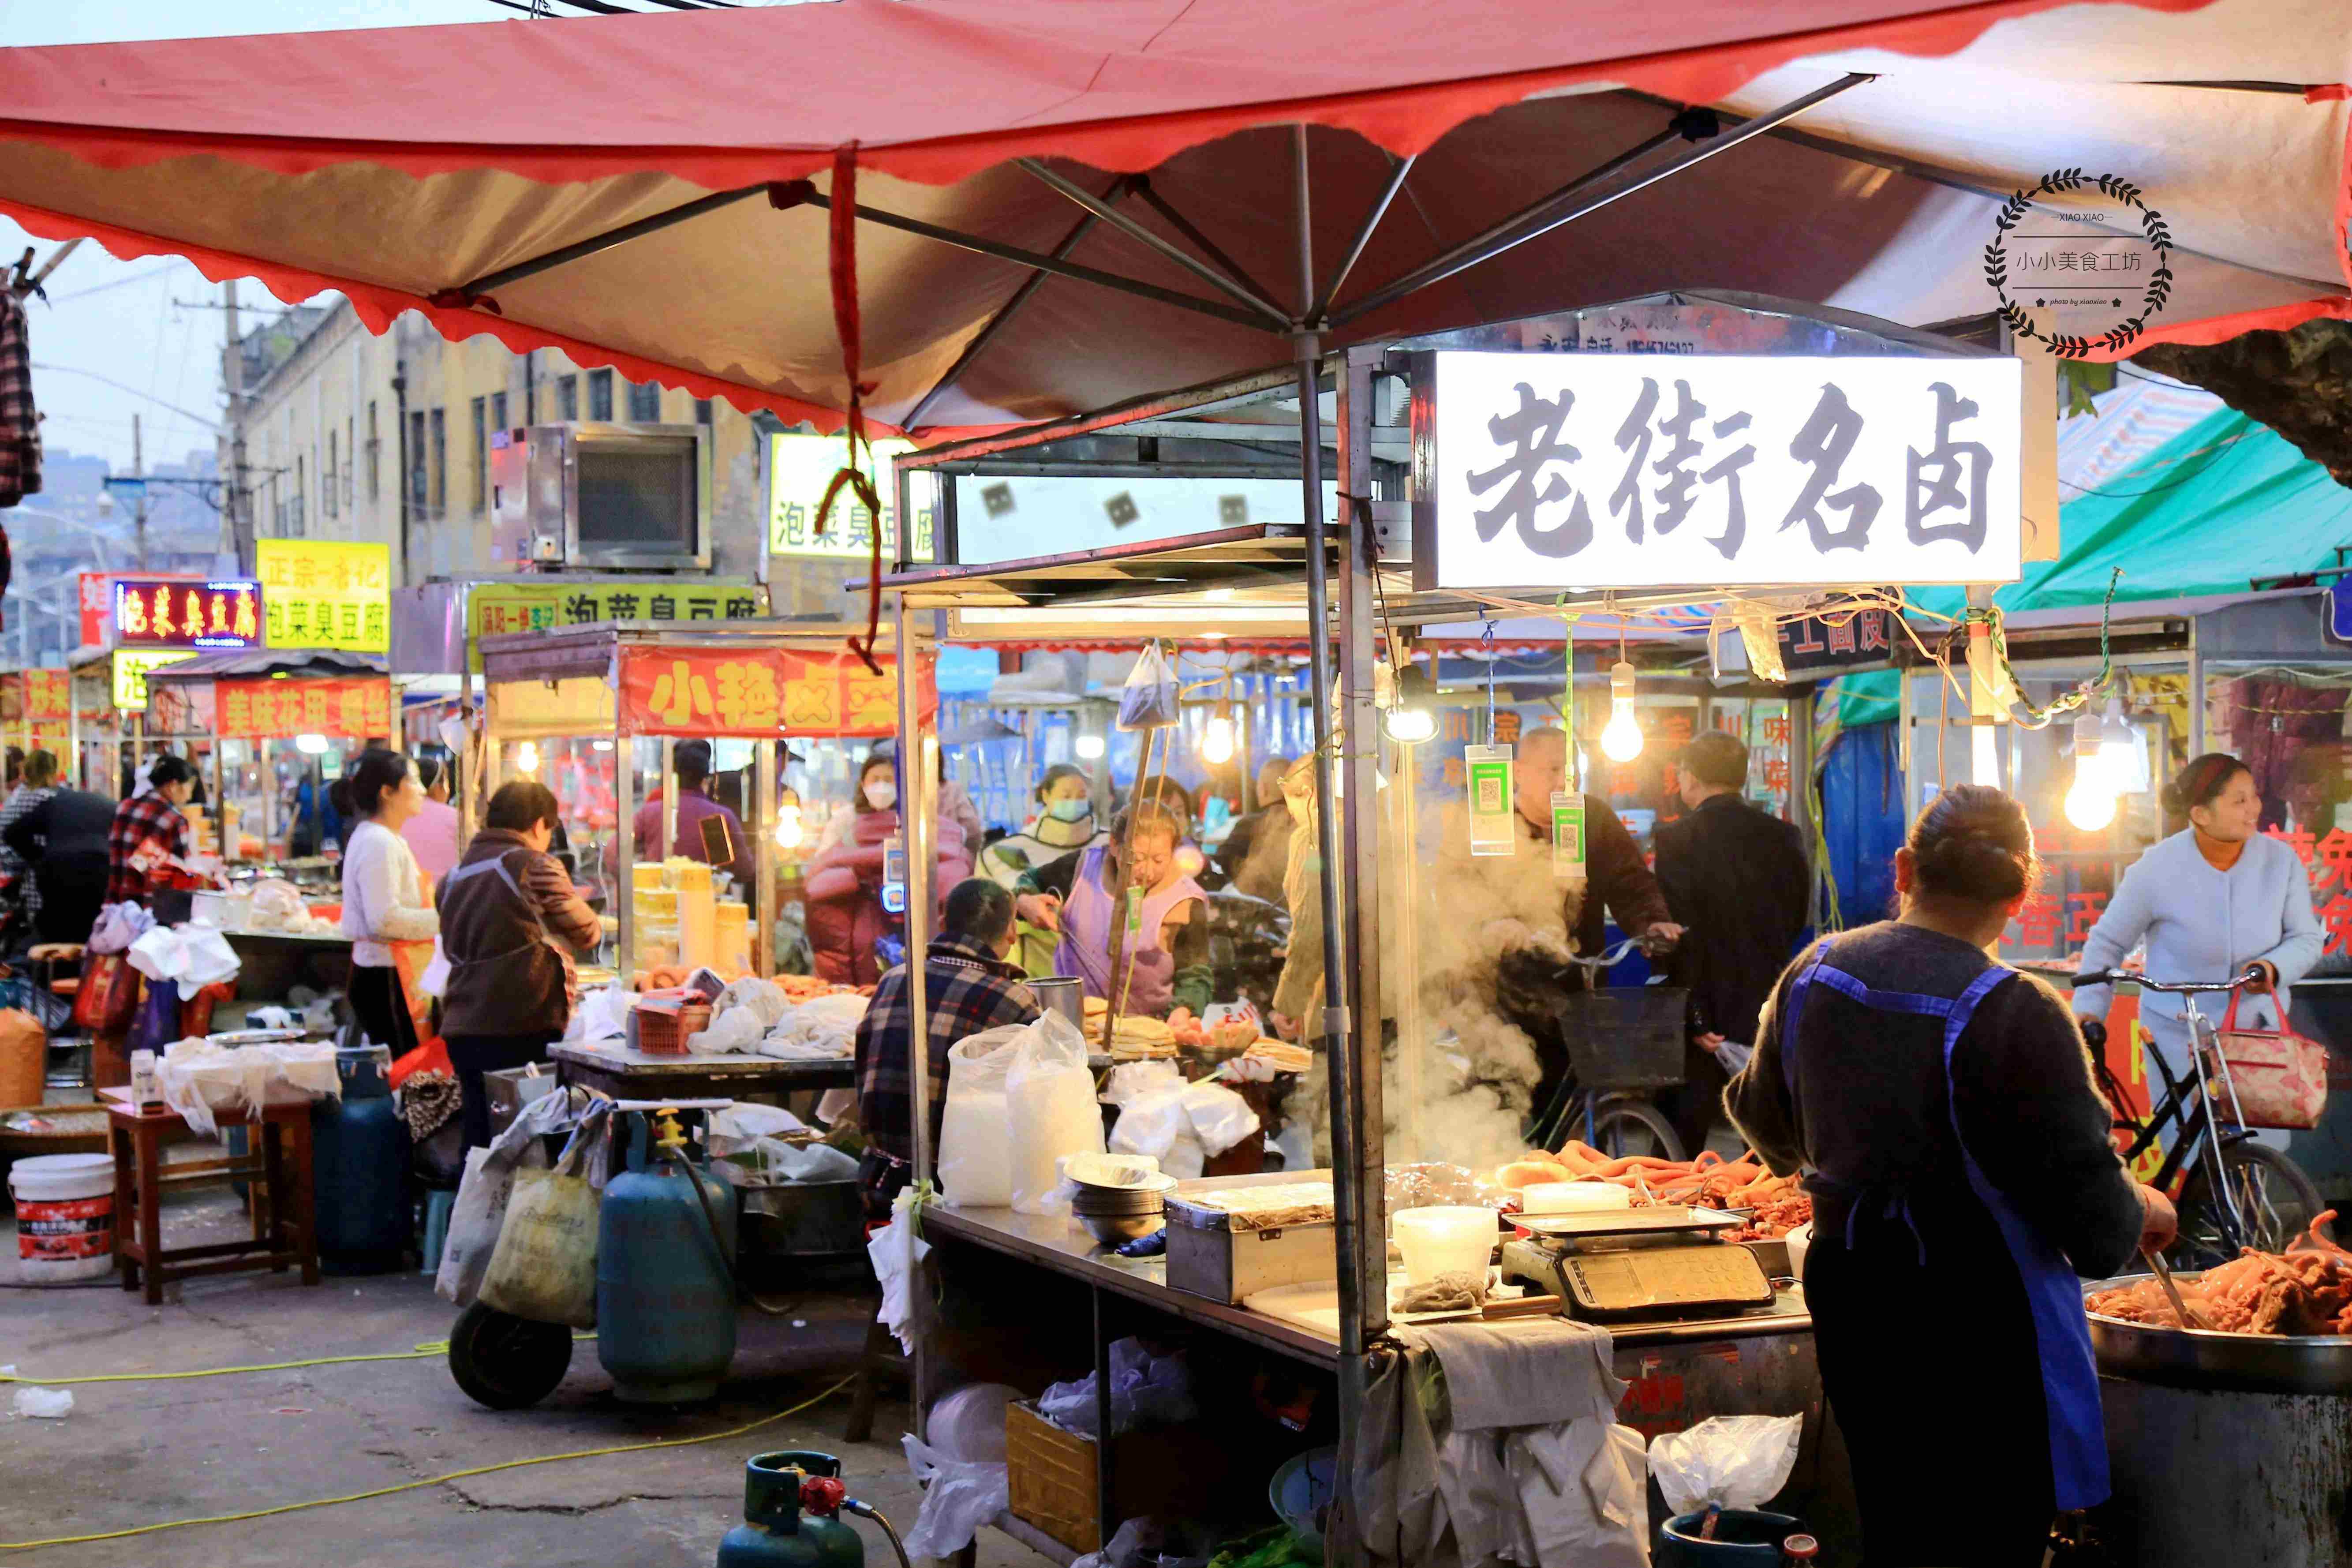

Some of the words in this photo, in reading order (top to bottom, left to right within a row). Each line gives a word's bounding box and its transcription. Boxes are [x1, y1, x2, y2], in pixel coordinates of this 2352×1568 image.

[1466, 377, 1994, 560] 老街名卤
[125, 586, 257, 638] 泡菜臭豆腐
[266, 600, 384, 641] 泡菜臭豆腐
